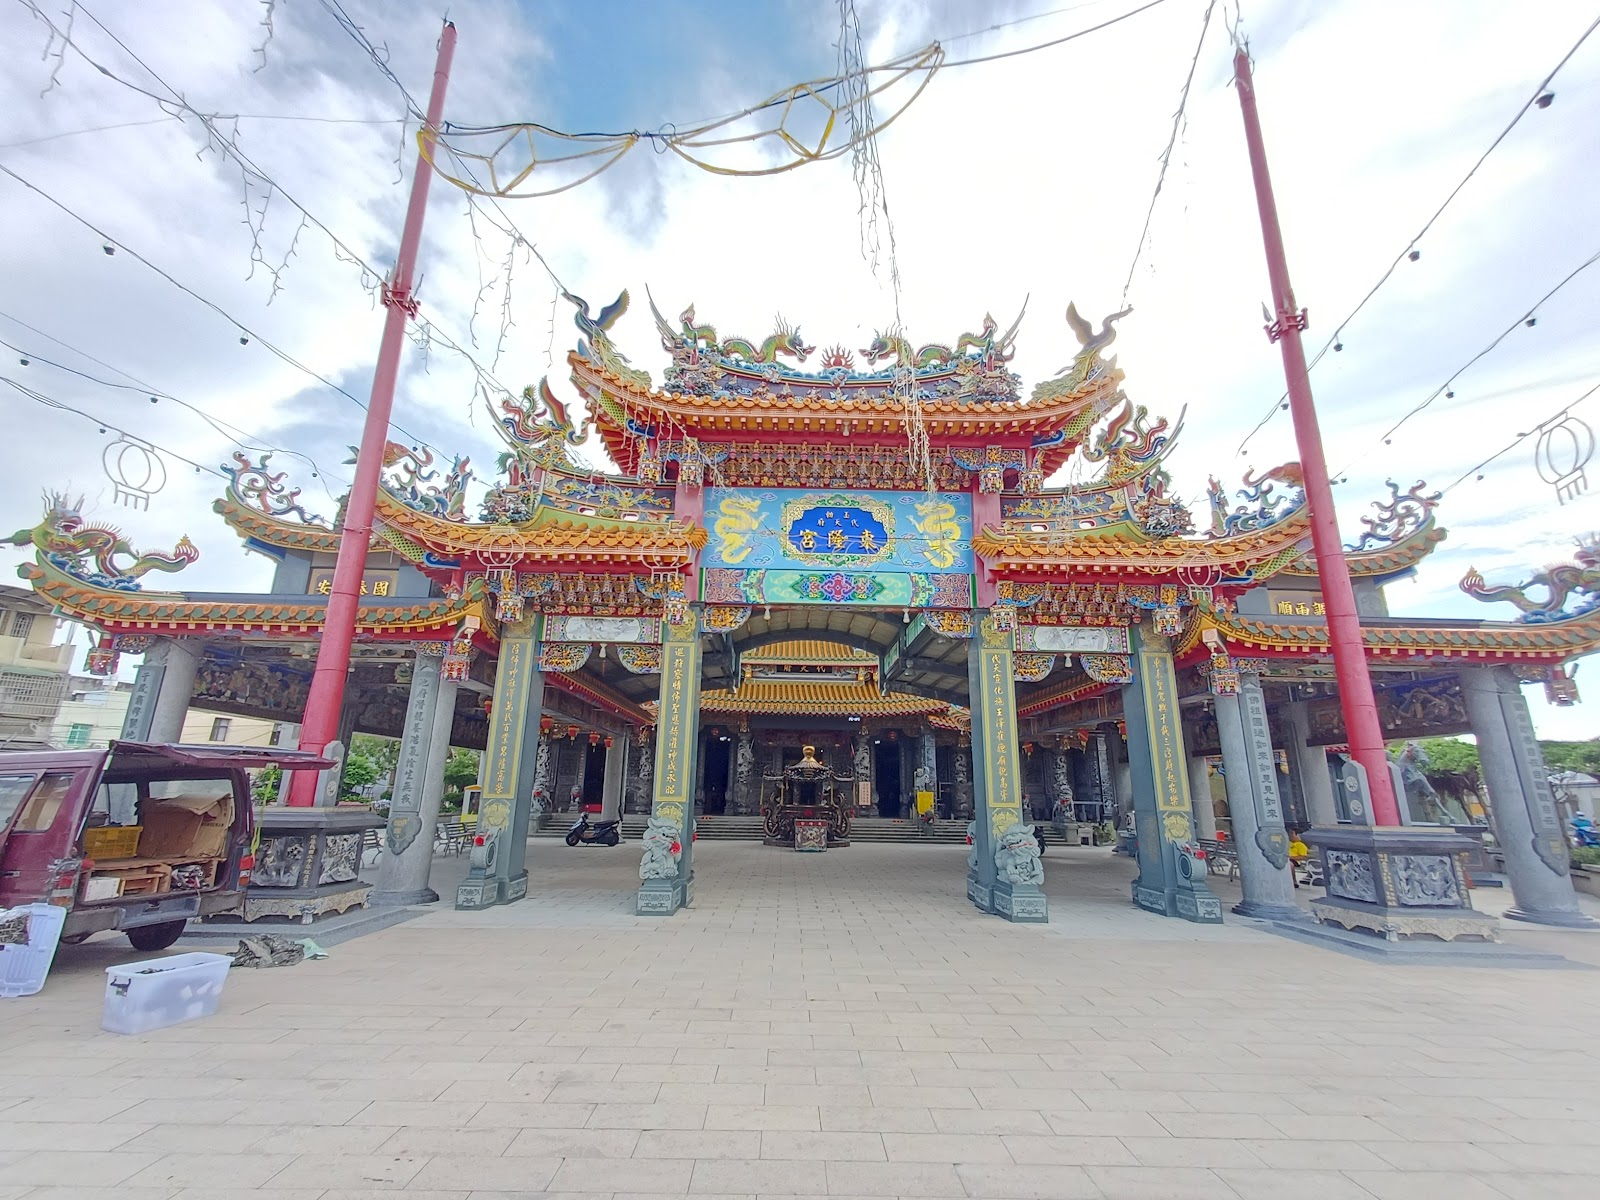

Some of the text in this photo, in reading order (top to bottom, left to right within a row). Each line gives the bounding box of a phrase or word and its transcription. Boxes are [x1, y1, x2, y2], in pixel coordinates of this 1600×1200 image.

[817, 518, 859, 527] 代天府
[800, 529, 877, 550] 東隆宮
[316, 580, 389, 596] 國泰安
